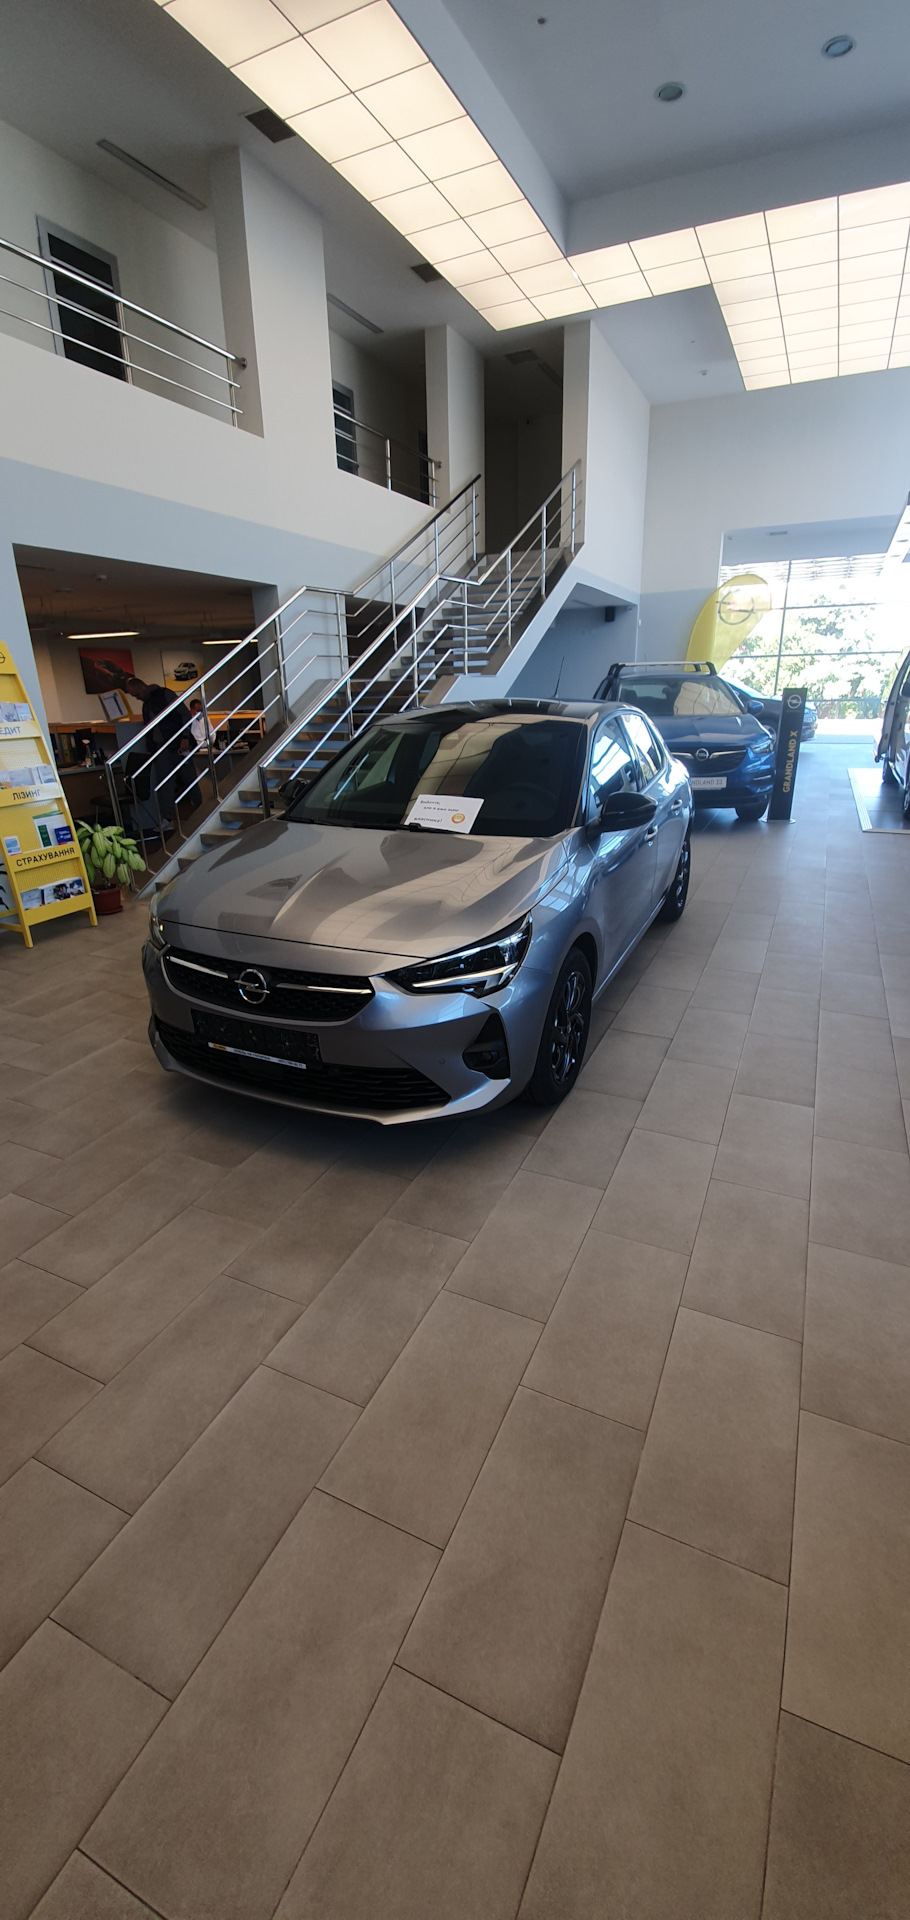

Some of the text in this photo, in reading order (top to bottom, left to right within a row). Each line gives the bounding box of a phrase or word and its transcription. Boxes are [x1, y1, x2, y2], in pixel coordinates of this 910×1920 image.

[782, 730, 798, 793] GRANDLAND X
[12, 788, 41, 801] ЛІЗИНГ
[16, 847, 75, 867] СТРАХУВАННЯ
